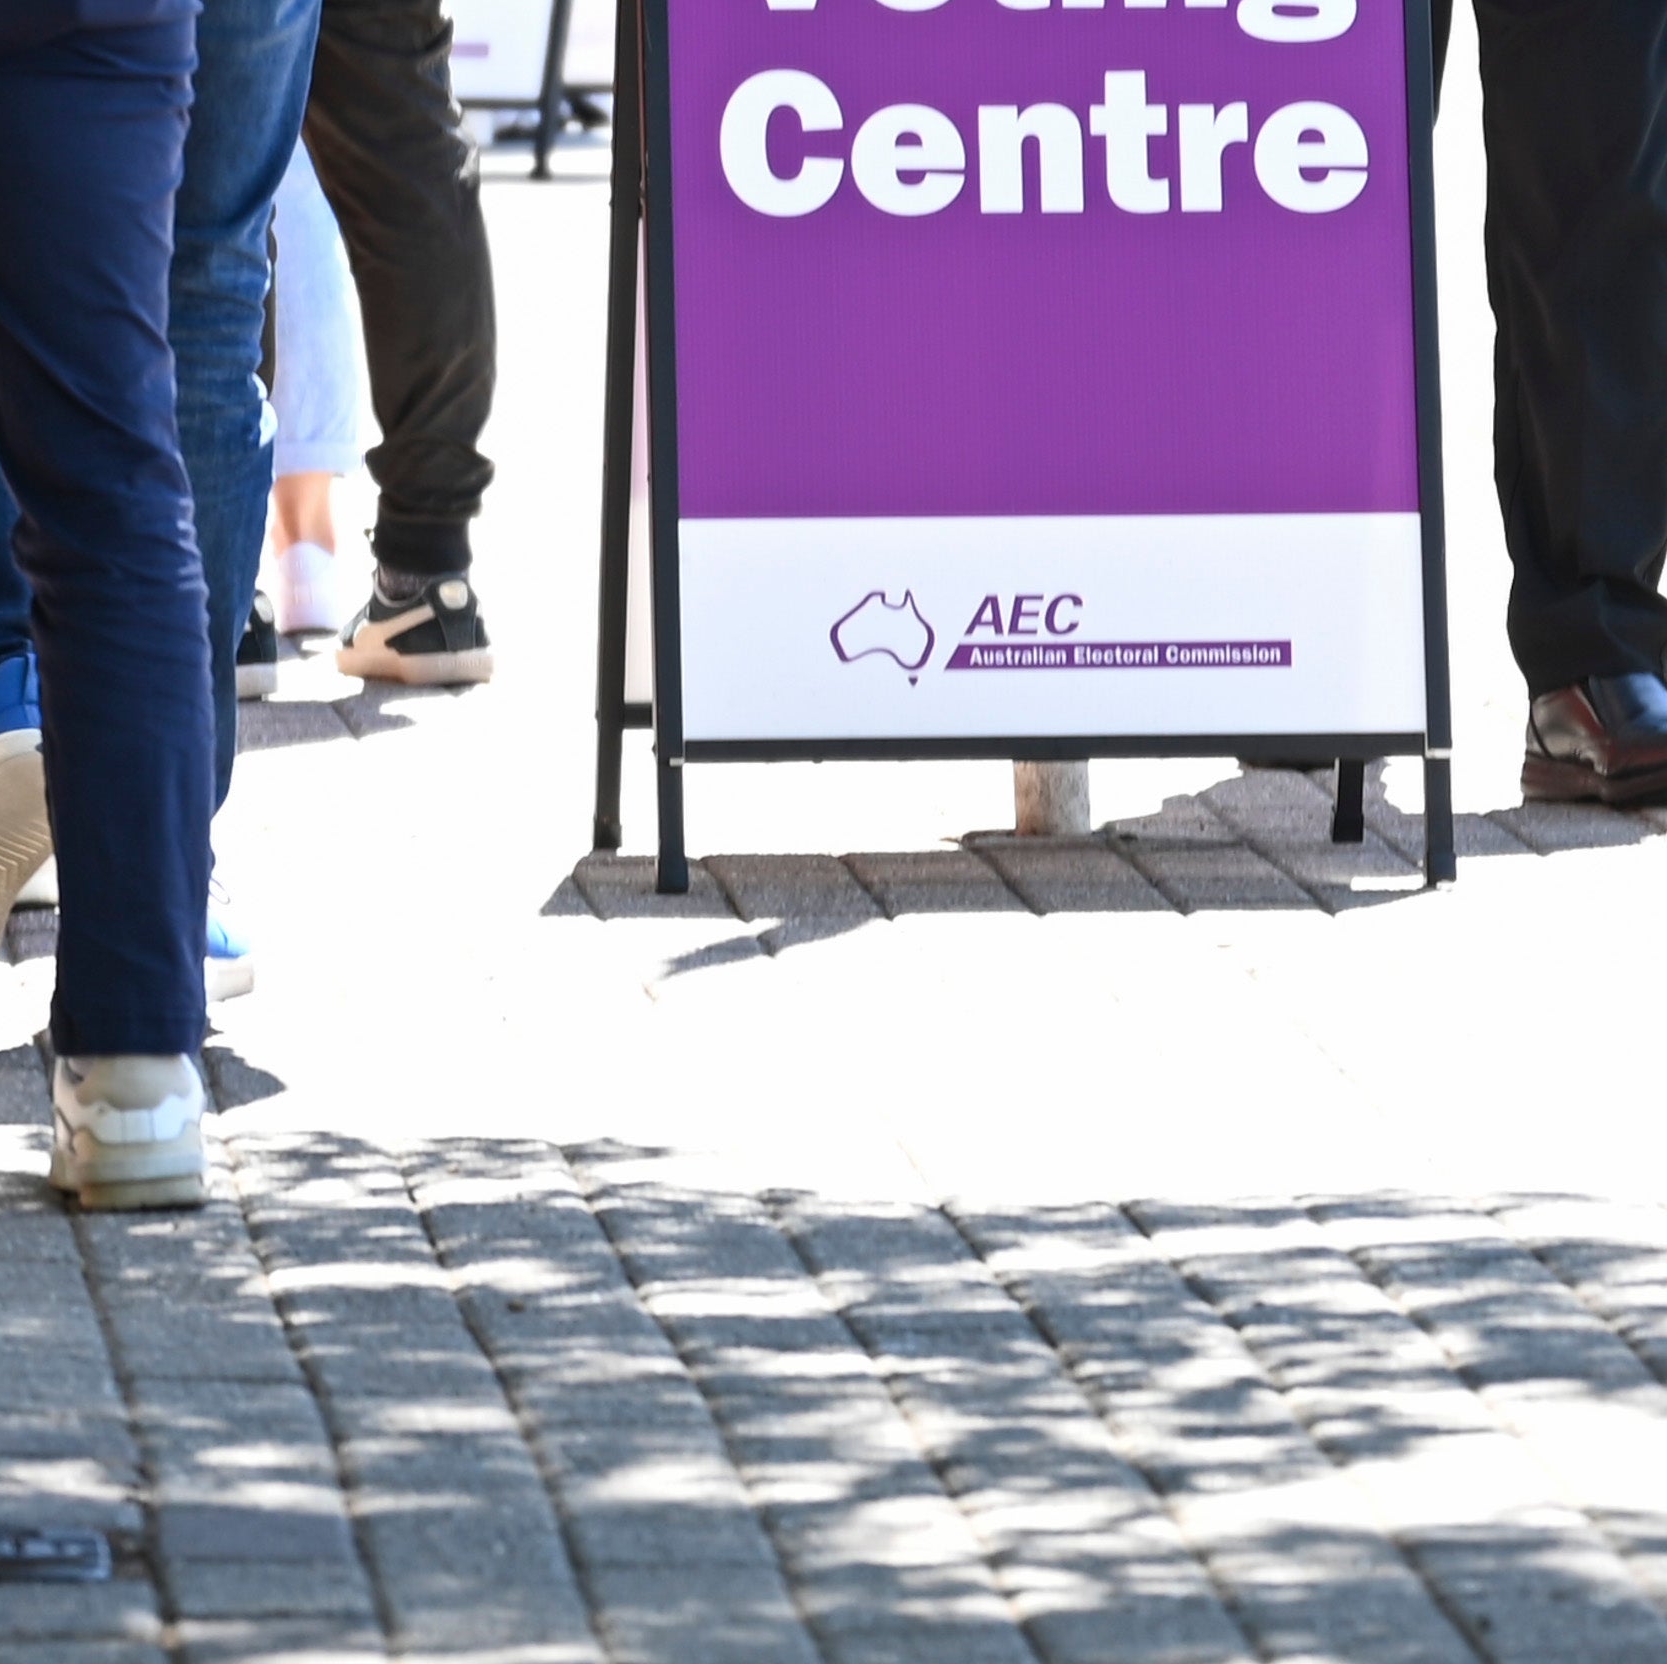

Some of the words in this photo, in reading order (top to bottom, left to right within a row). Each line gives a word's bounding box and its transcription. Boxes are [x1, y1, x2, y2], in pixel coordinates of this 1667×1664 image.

[718, 68, 1370, 218] Centre
[964, 594, 1084, 636] AEC
[969, 645, 1068, 667] Australian
[1073, 645, 1160, 666] Electoral
[1165, 644, 1282, 665] Commission
